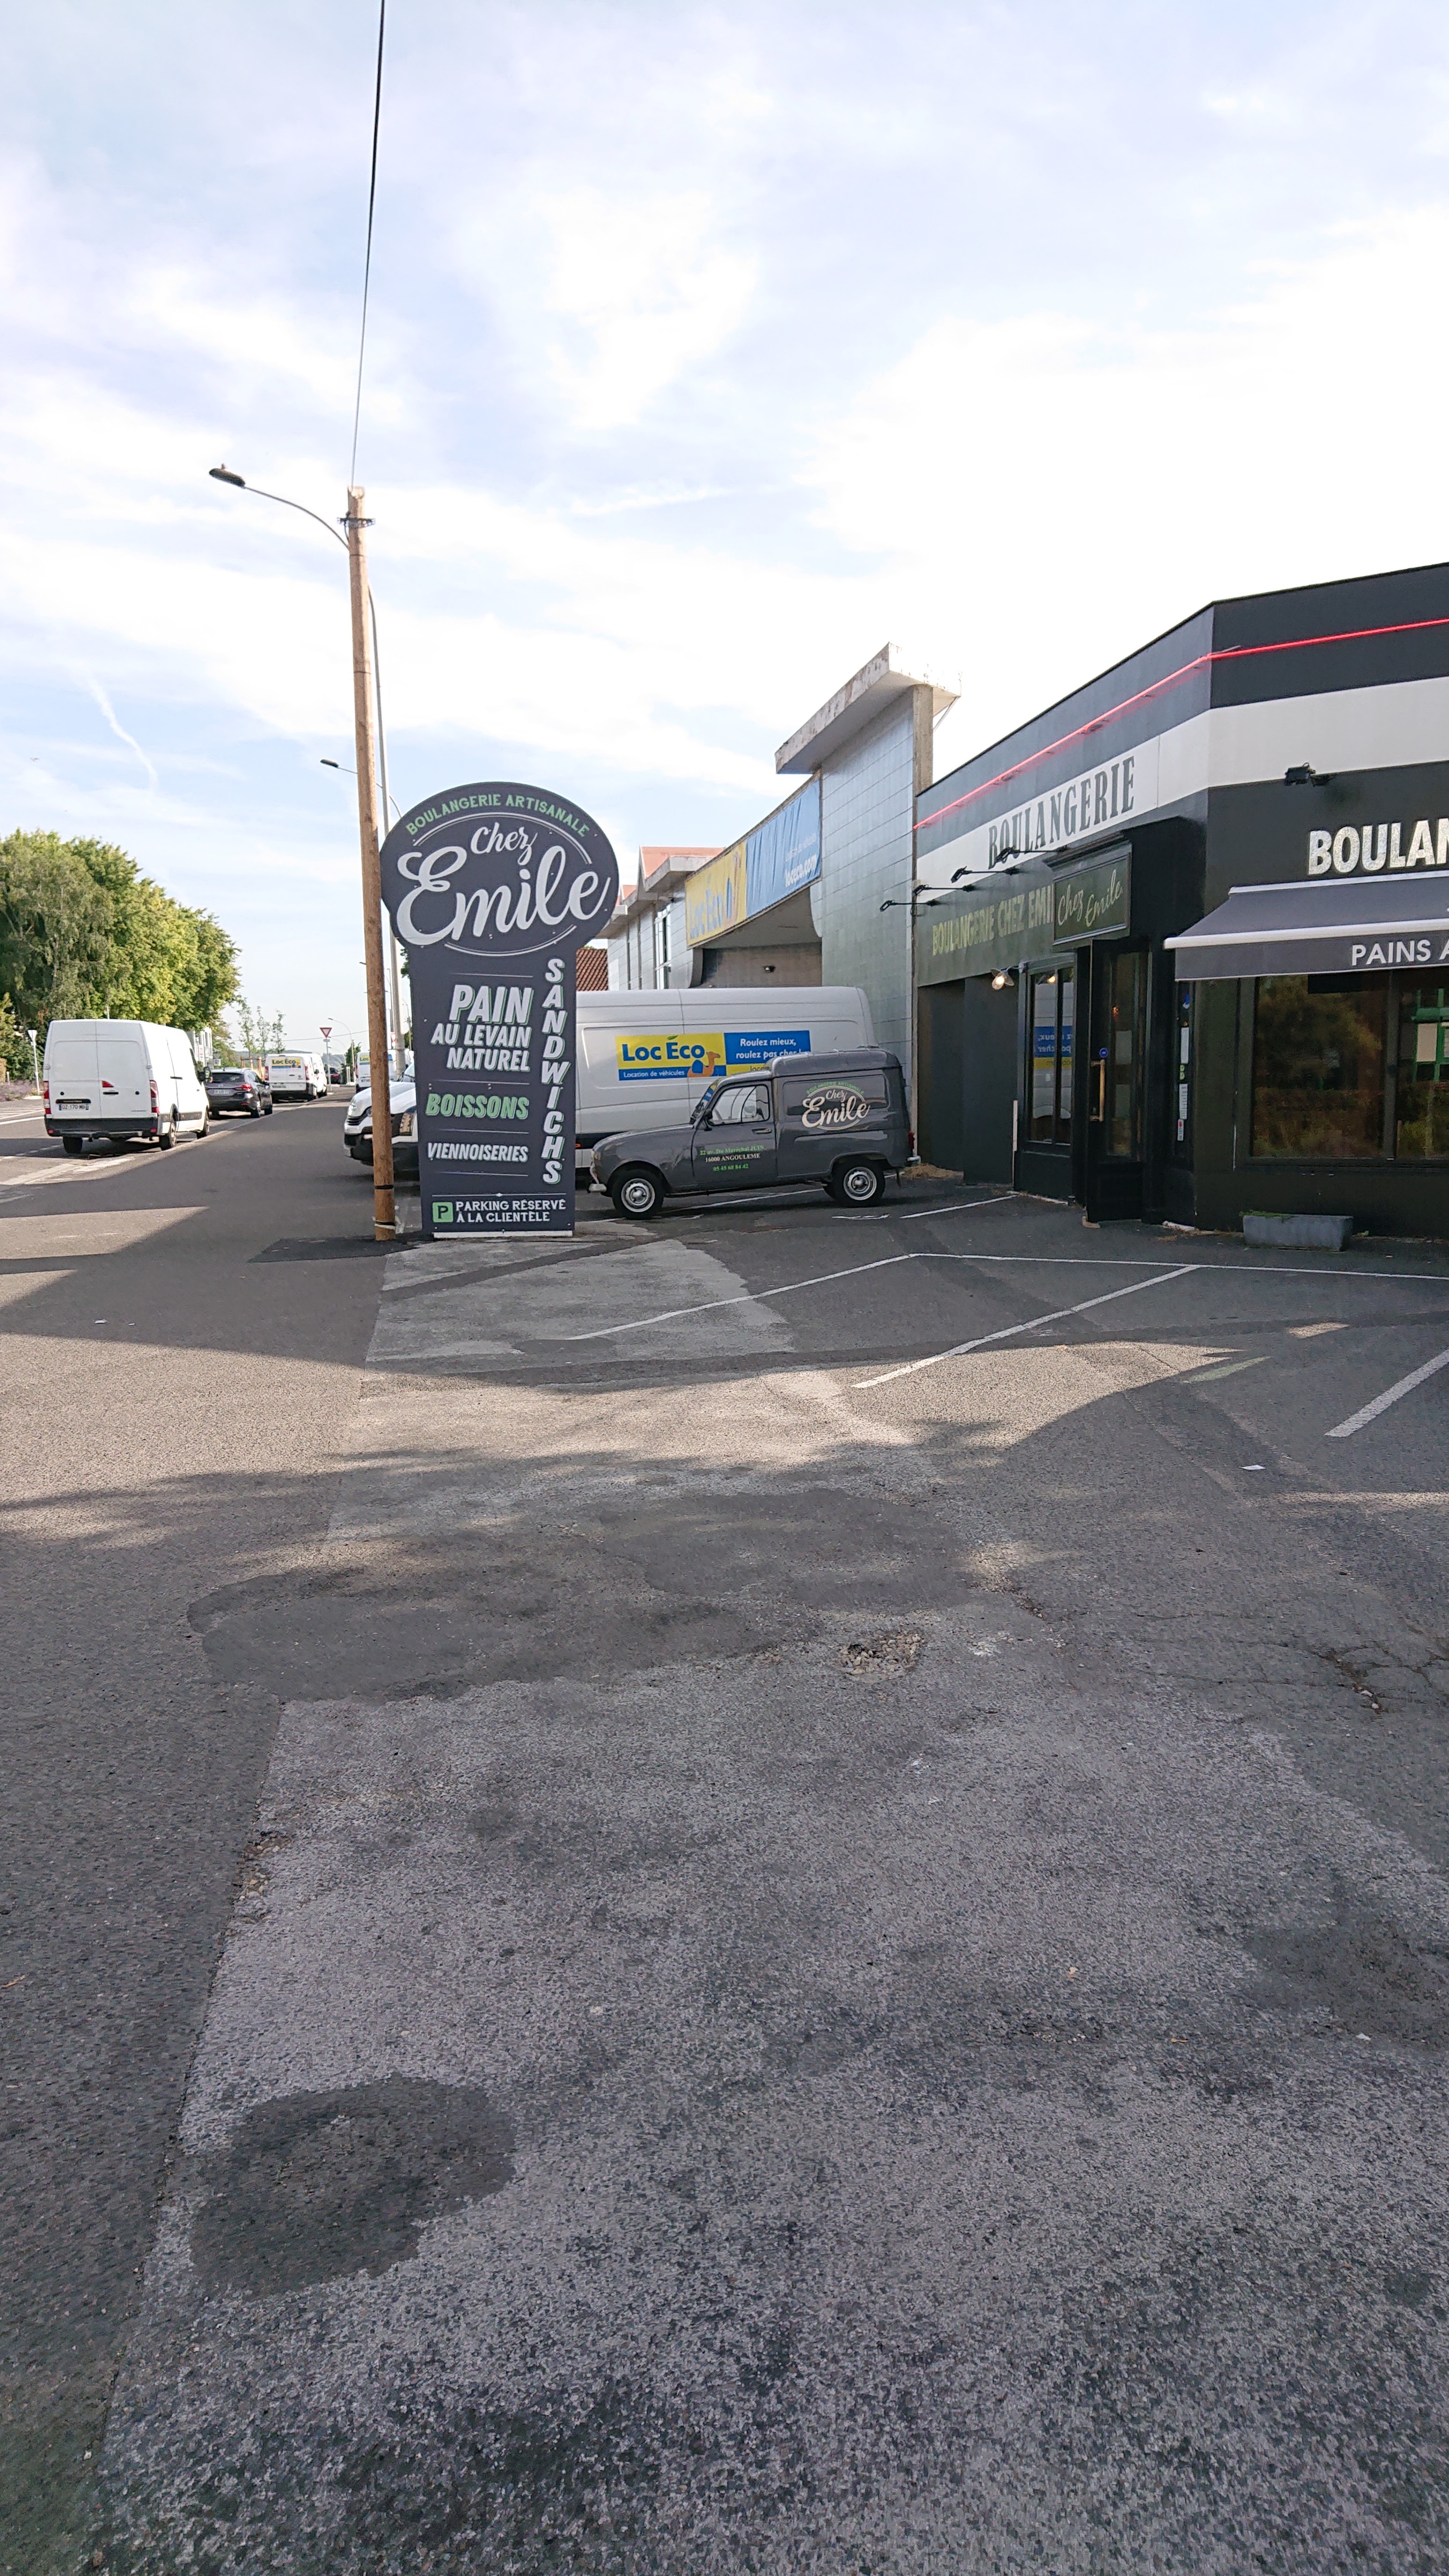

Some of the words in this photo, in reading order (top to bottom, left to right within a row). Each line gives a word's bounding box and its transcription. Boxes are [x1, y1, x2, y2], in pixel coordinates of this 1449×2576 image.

[406, 794, 501, 835] BOULANGERIE
[505, 795, 589, 837] ARTISANALE
[988, 755, 1135, 870] BOULANGERIE
[397, 846, 610, 945] Emile
[1057, 885, 1083, 926] Chez
[1085, 869, 1123, 927] Emile
[933, 905, 994, 956] BOULANGERIE
[998, 894, 1025, 937] CHEZ
[1352, 939, 1430, 966] PAINS
[449, 984, 534, 1025] PAIN
[431, 1023, 460, 1046] AU
[464, 1024, 532, 1048] LEVAIN
[740, 1037, 768, 1046] Roulez
[769, 1037, 797, 1046] mieux,
[446, 1047, 530, 1071] NATUREL
[622, 1044, 661, 1061] Loc
[736, 1051, 761, 1060] roulez
[763, 1052, 777, 1061] pas
[541, 958, 571, 1185] SANDWICHS
[623, 1070, 649, 1078] Location
[806, 1081, 837, 1095] BOULANGERIE
[838, 1082, 864, 1095] ARTISANALE
[425, 1093, 529, 1120] BOISSONS
[801, 1096, 871, 1128] Emile
[428, 1142, 528, 1162] VIENNOISERIES
[455, 1200, 509, 1211] PARKING
[512, 1198, 566, 1210] RÉSERVÉ
[468, 1212, 483, 1222] LA
[486, 1210, 550, 1222] CLIENTÈLE
